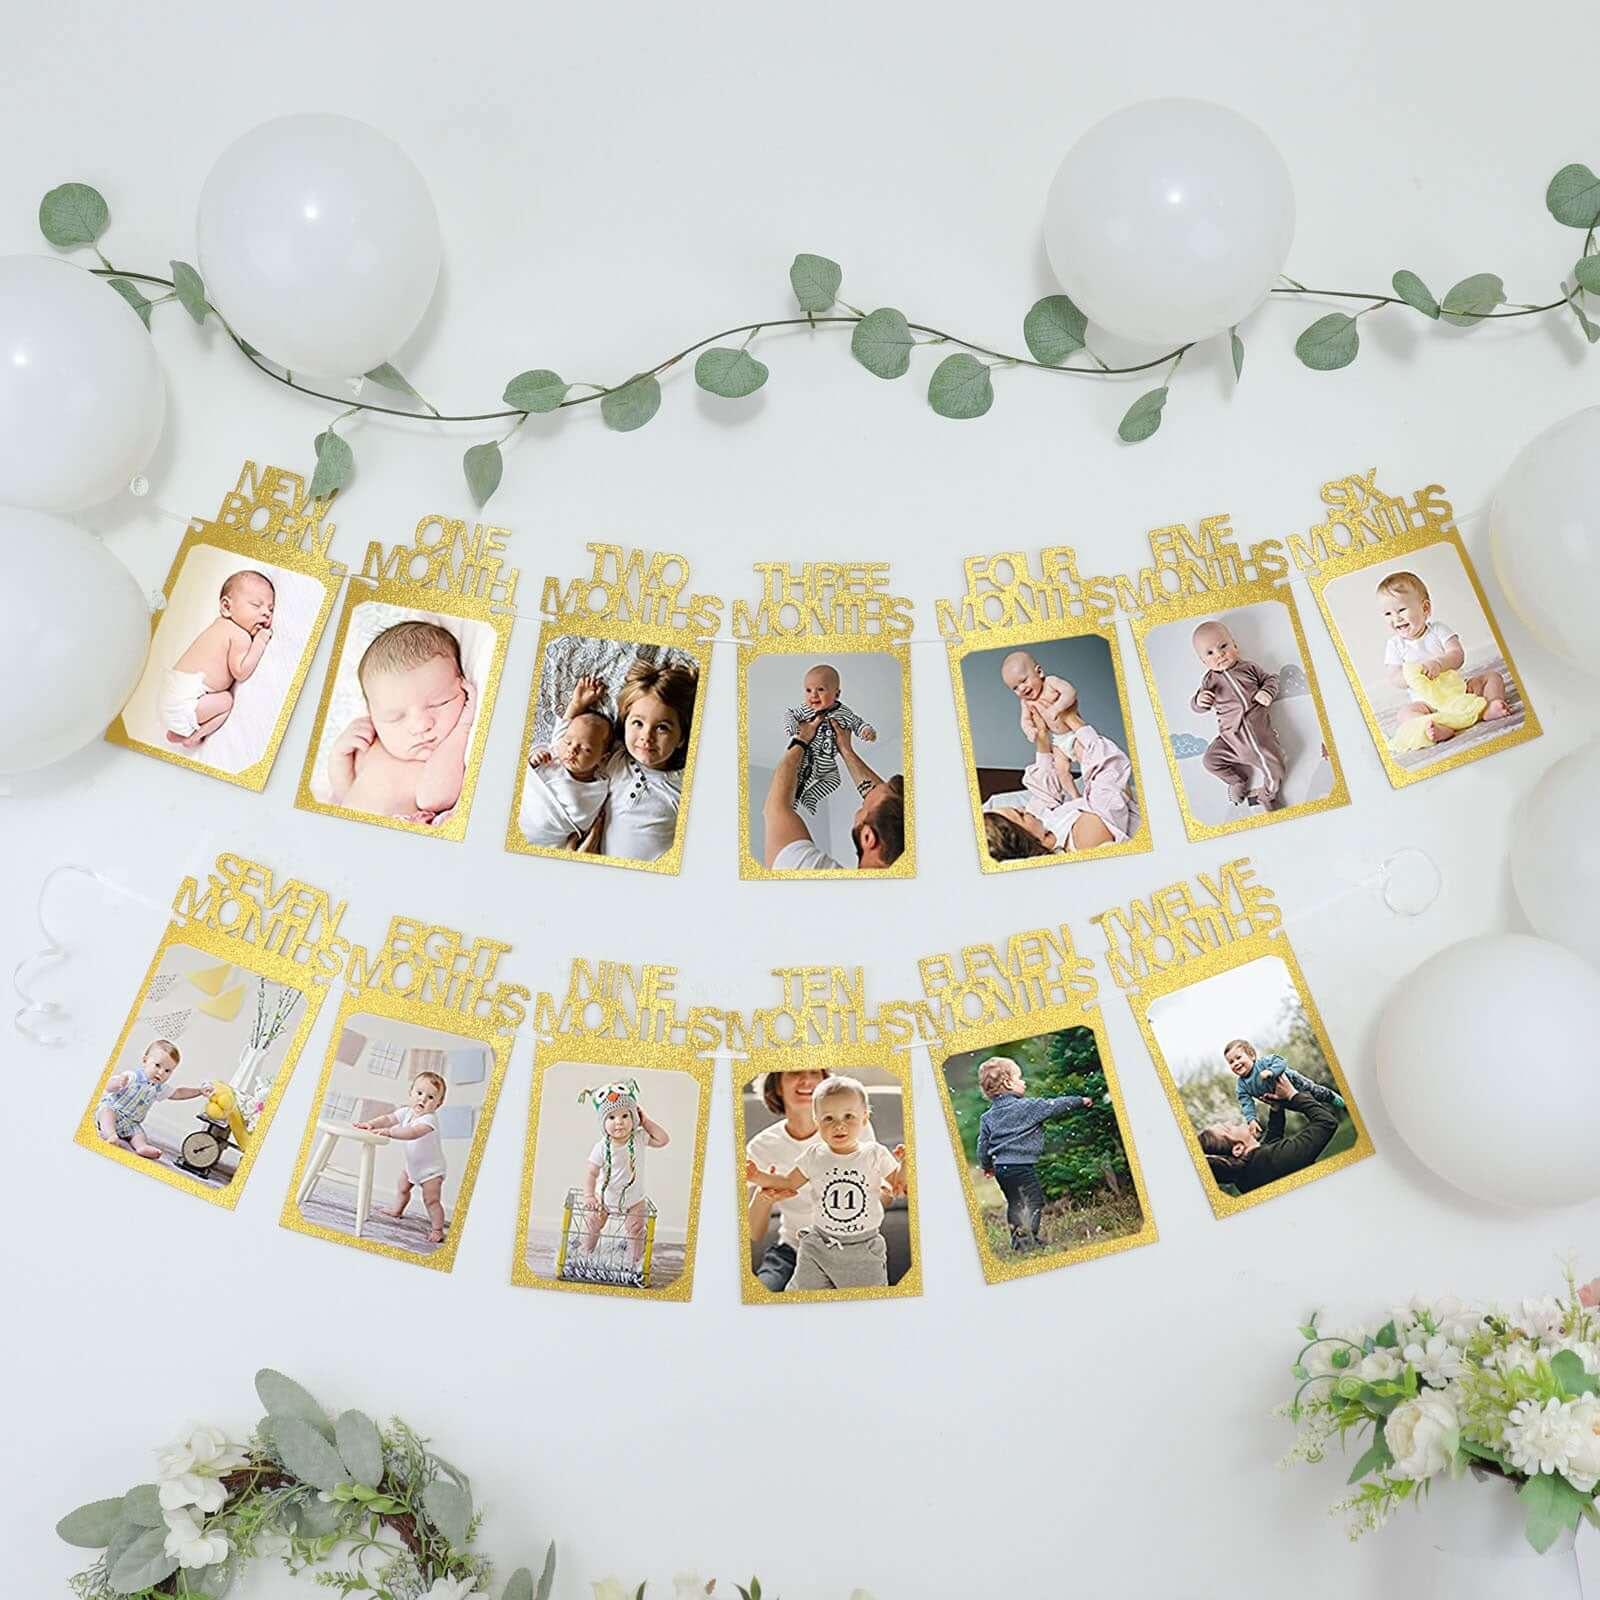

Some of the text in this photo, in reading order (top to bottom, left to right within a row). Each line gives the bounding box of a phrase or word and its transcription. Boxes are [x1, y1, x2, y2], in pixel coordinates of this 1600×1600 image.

[234, 460, 340, 521] NEW
[1320, 467, 1391, 516] SIX
[216, 491, 336, 557] BORN
[415, 514, 512, 562] ONE
[1148, 513, 1234, 566] FIVE
[1286, 484, 1454, 570] MONTHS
[361, 541, 519, 607] MONTH
[587, 542, 689, 592] TWO
[753, 561, 890, 600] THREE
[963, 546, 1084, 594] FOUR
[1113, 539, 1291, 612] MONTHS
[540, 577, 724, 636] MONTHS
[732, 597, 914, 638] MONTHS
[936, 576, 1116, 636] MONTHS
[208, 852, 347, 941] SEVEN
[1090, 857, 1257, 950] TWELVE
[172, 876, 349, 979] MONTHS
[384, 915, 512, 981] EIGHT
[1104, 887, 1282, 987] MONTHS
[344, 944, 530, 1026] MONTHS
[567, 958, 678, 1008] NINE
[772, 966, 864, 1008] TEN
[918, 923, 1076, 996] ELEVEN
[533, 992, 726, 1048] MONTHS
[727, 1002, 915, 1050] MONTHS
[914, 957, 1100, 1041] MONTHS
[830, 1190, 856, 1210] 11
